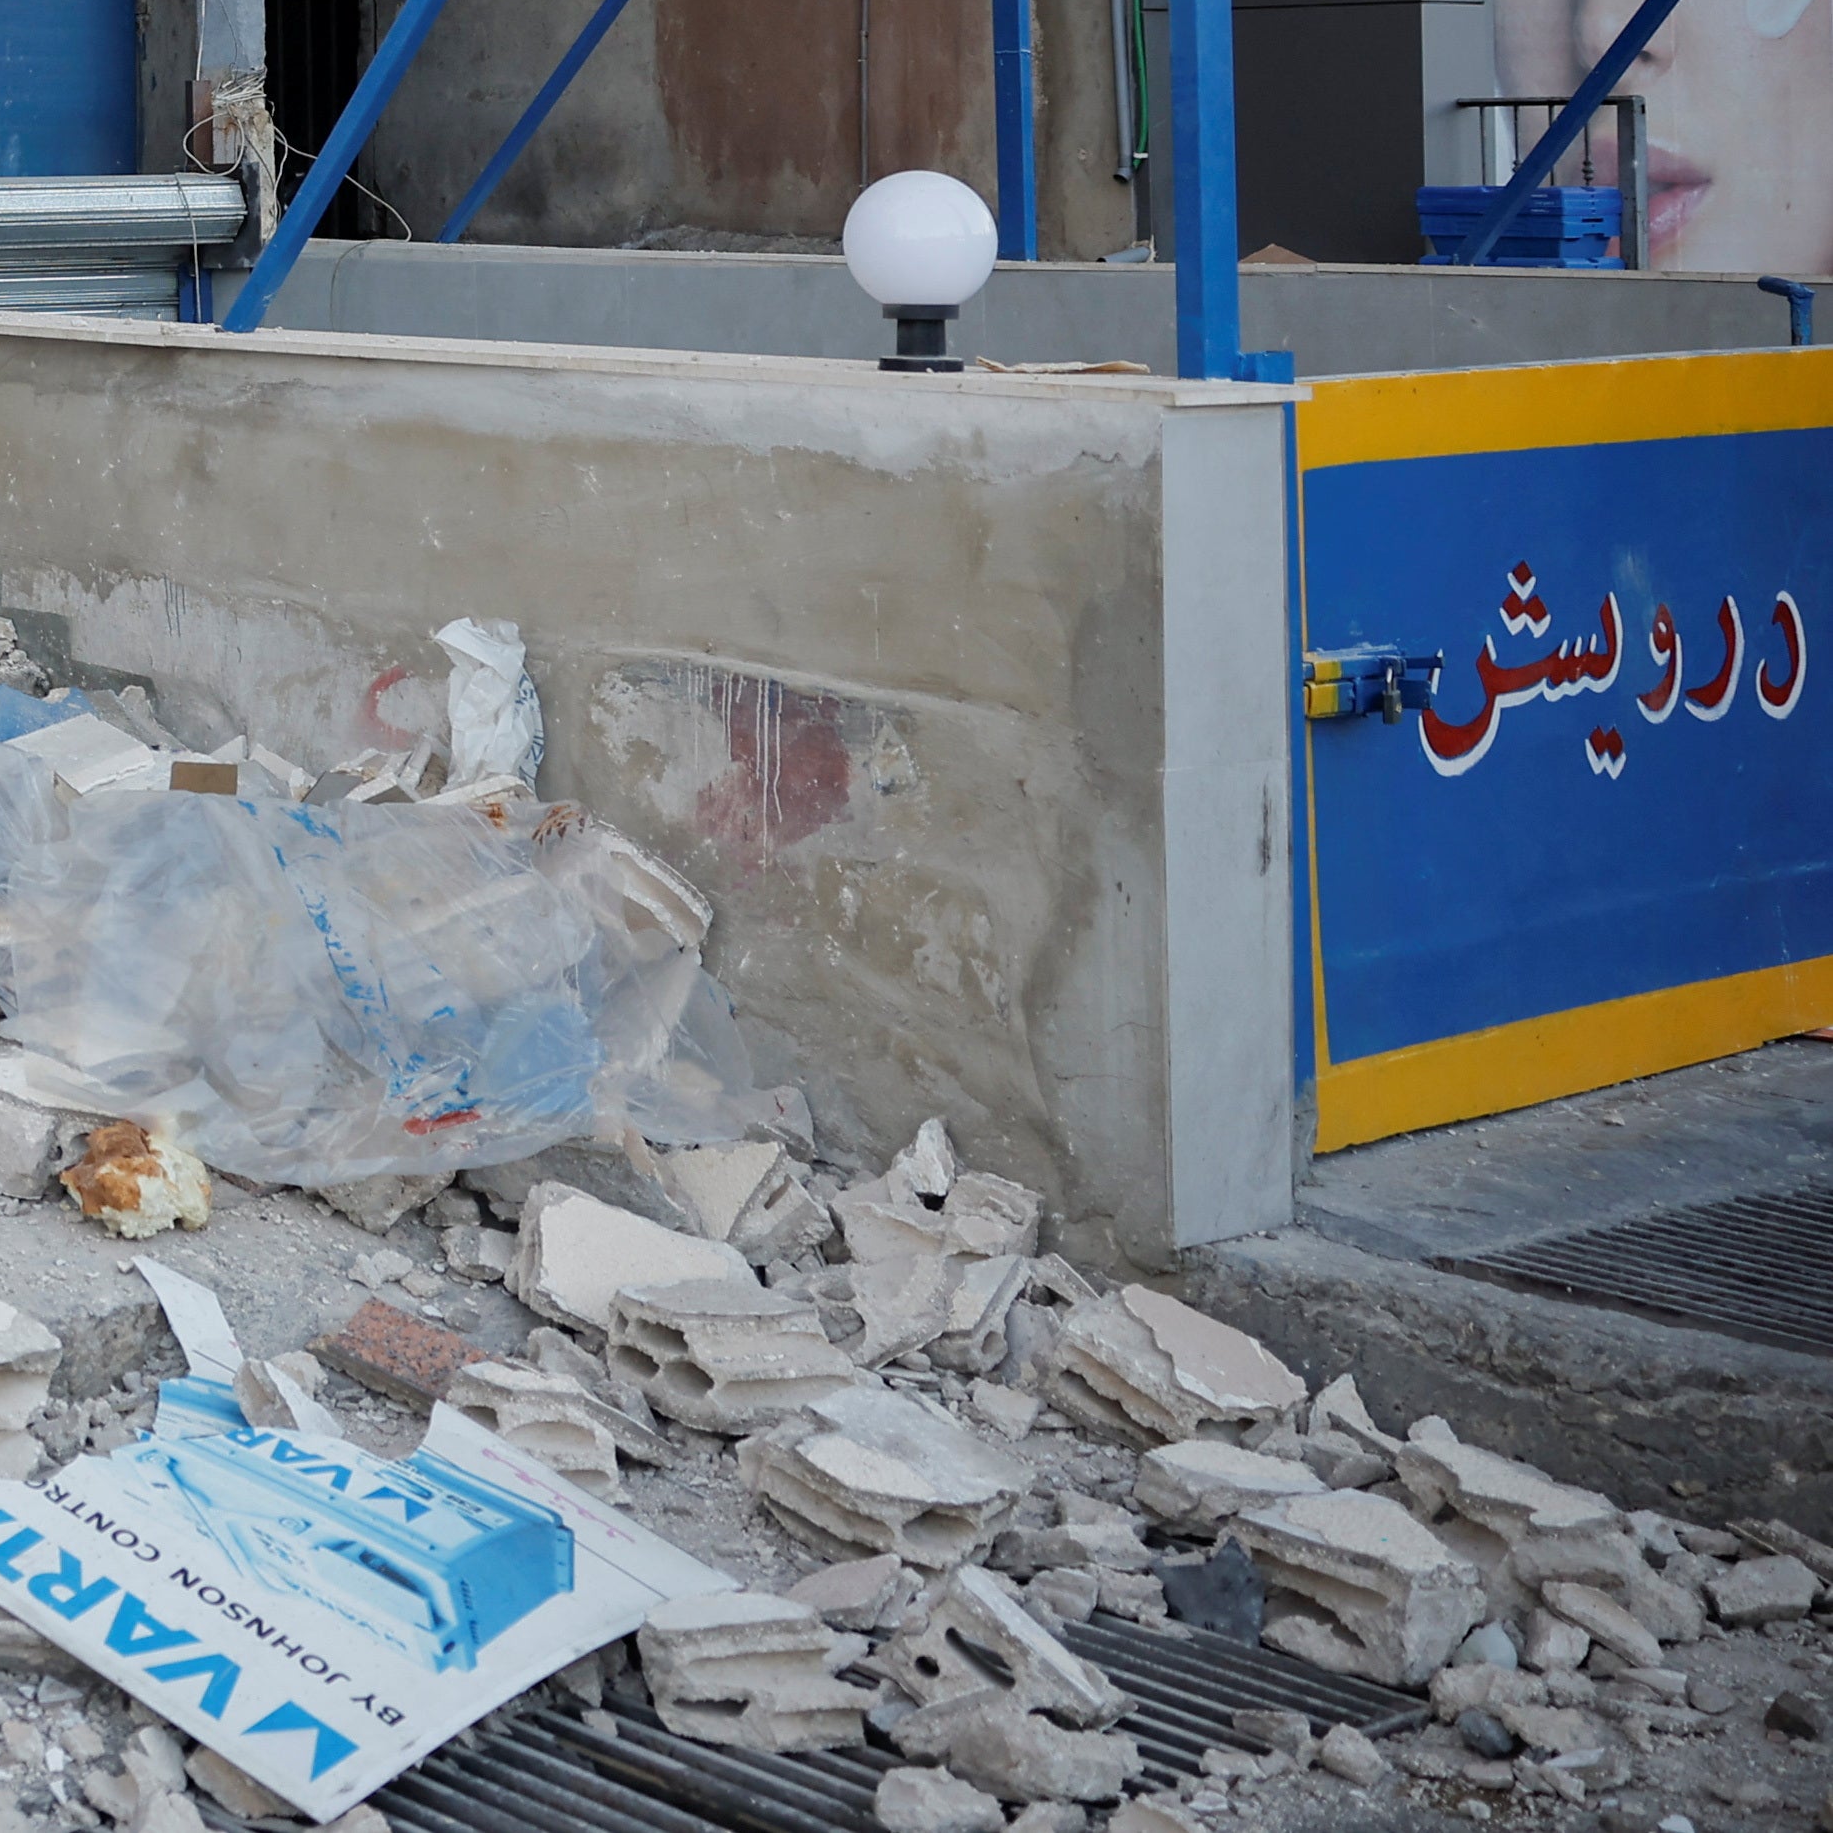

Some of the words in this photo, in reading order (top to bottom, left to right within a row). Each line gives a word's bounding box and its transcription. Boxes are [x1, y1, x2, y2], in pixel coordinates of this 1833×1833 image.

[1418, 558, 1808, 781] درويش
[169, 1566, 352, 1685] JOHNSON
[349, 1694, 407, 1727] BY
